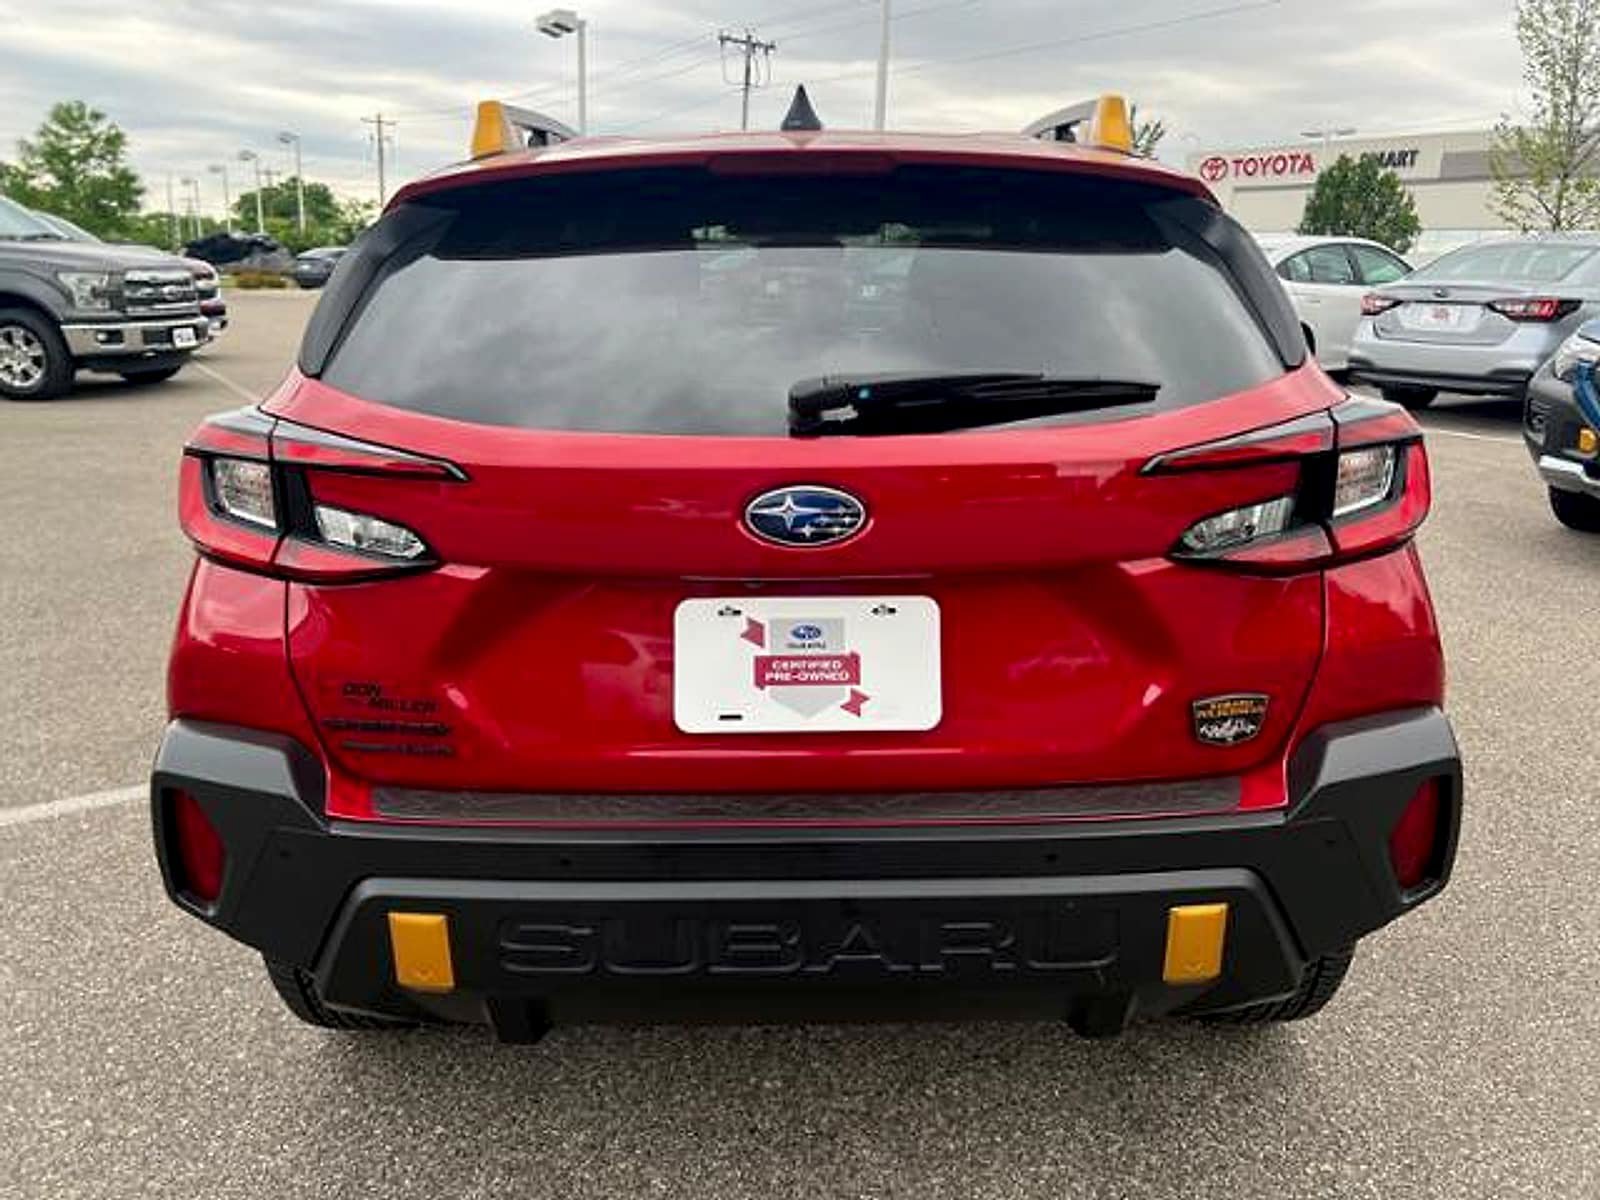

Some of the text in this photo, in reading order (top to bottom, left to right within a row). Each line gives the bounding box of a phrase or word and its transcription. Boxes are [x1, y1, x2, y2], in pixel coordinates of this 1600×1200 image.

[1232, 153, 1315, 177] TOYOTA
[771, 660, 842, 670] CERTIFIED
[764, 671, 850, 681] PRE-OWNED
[499, 921, 1119, 975] SUBARU
